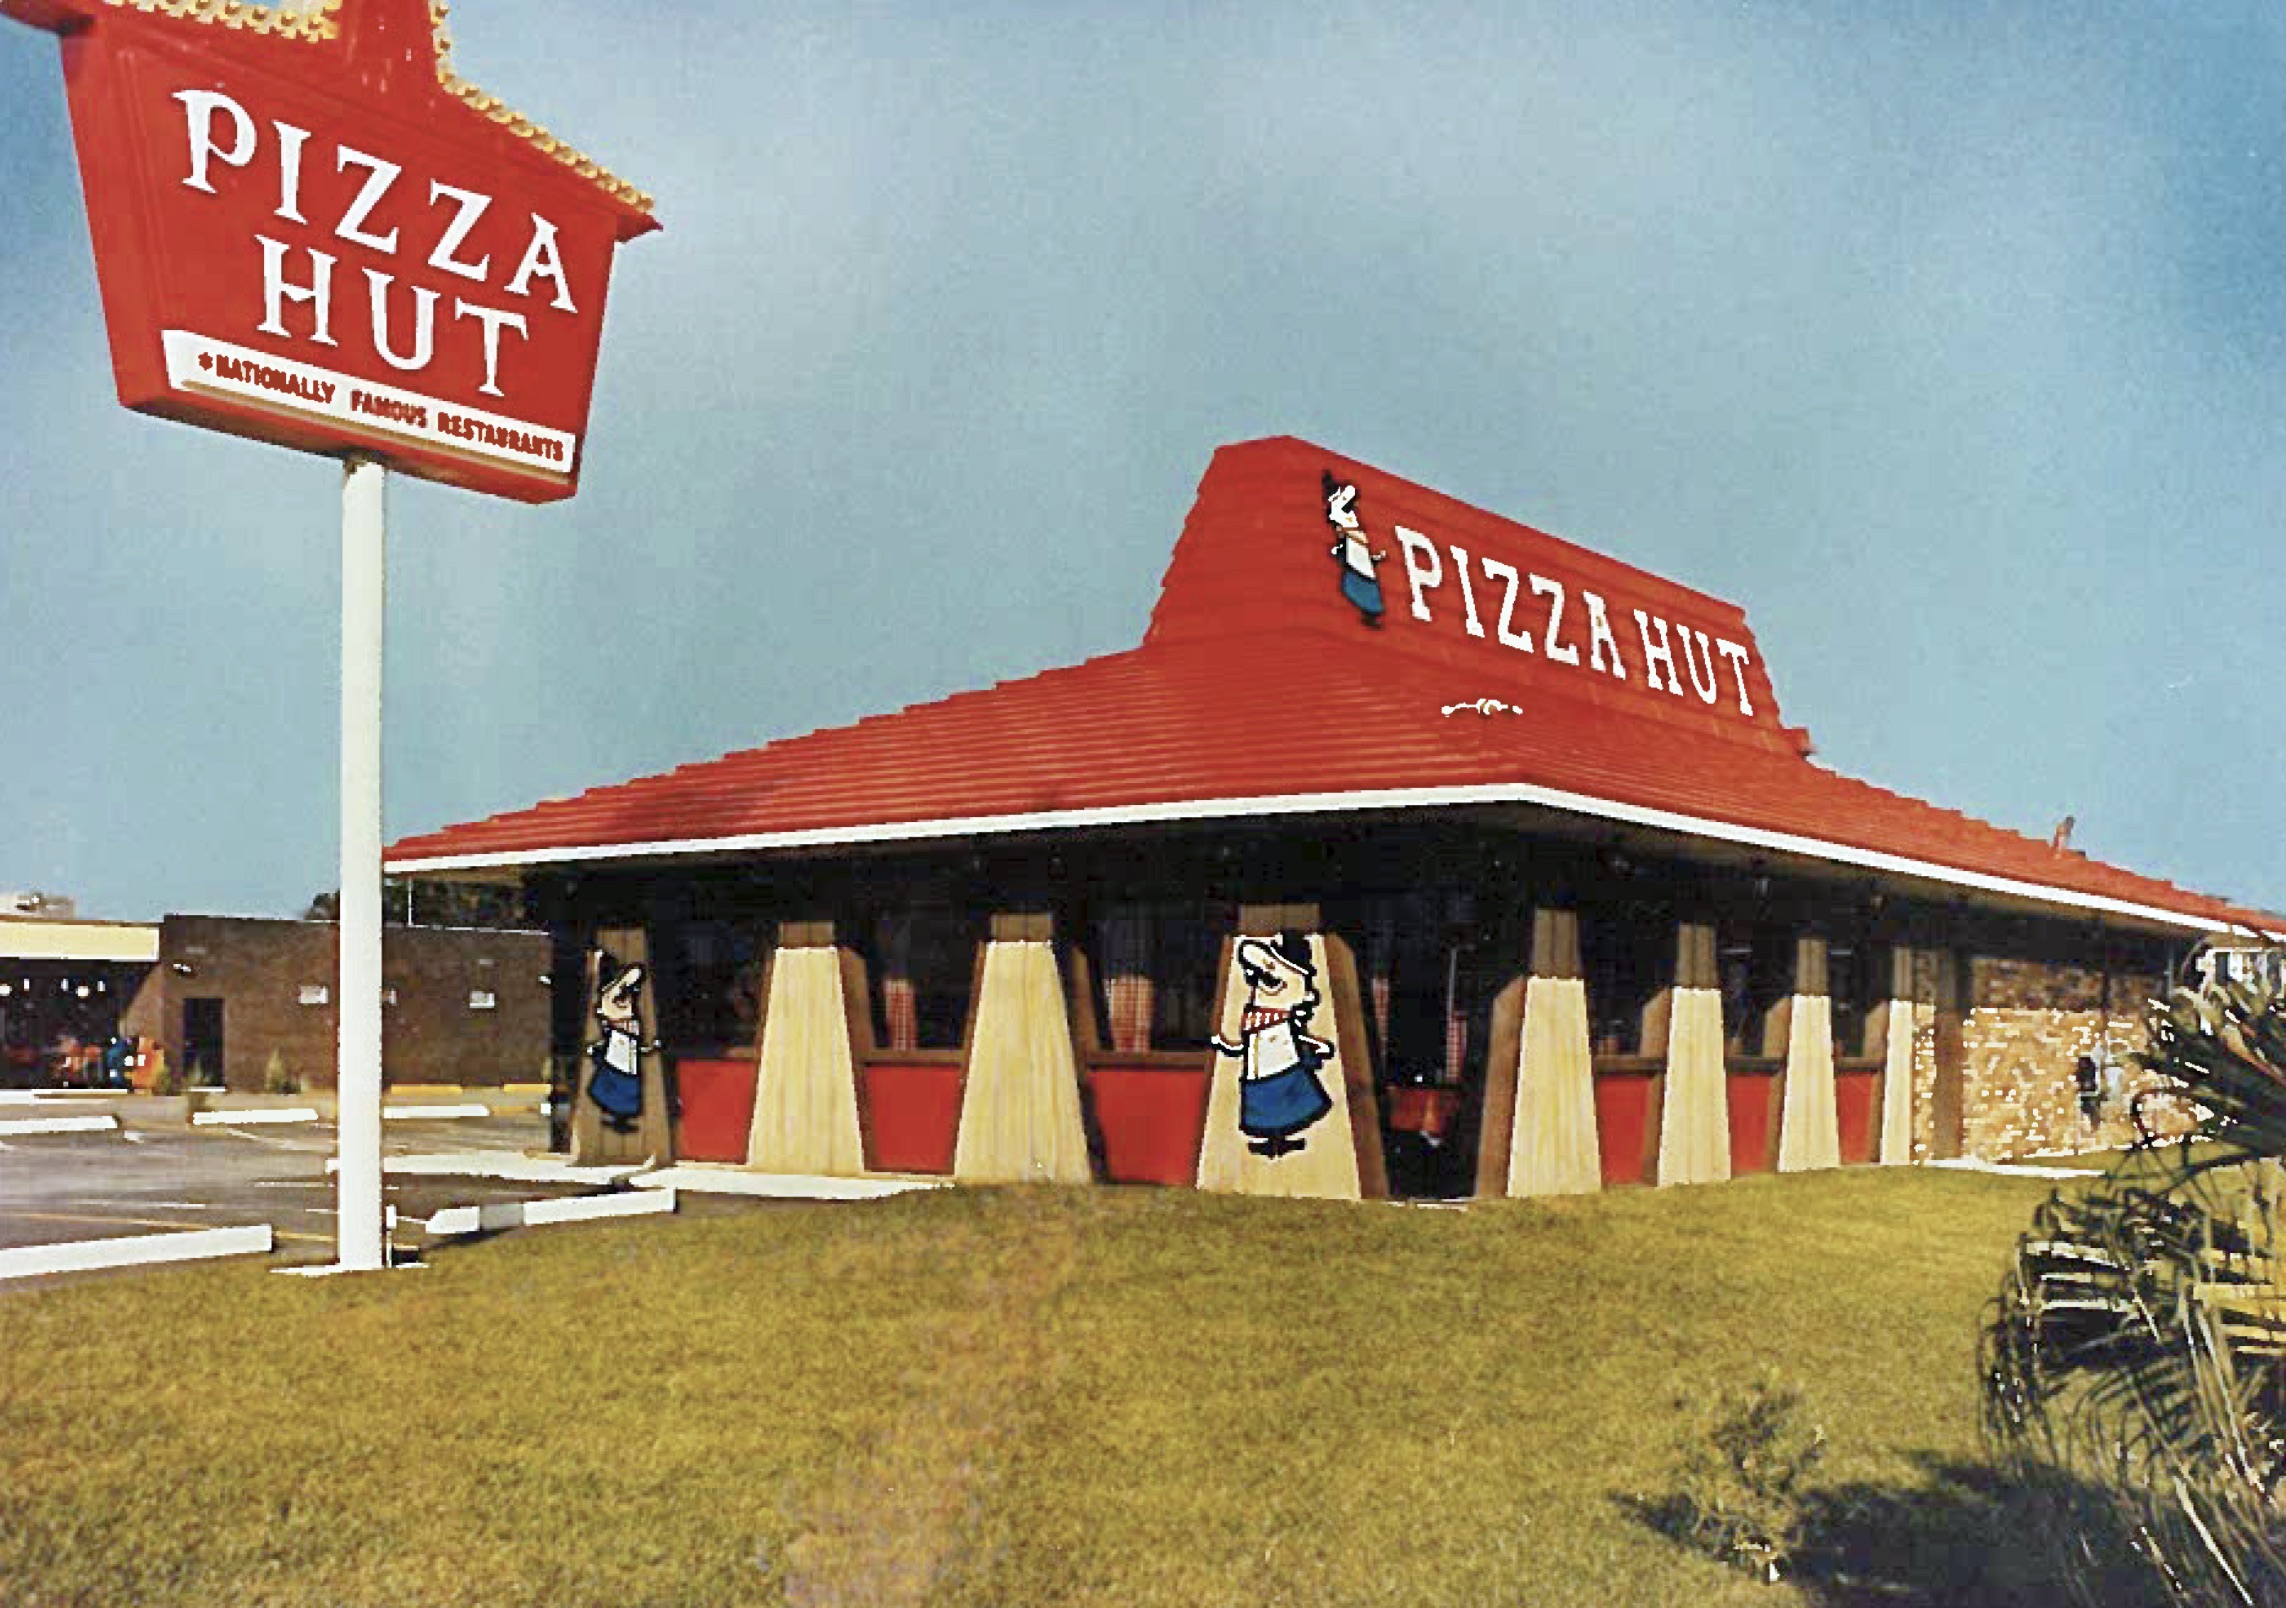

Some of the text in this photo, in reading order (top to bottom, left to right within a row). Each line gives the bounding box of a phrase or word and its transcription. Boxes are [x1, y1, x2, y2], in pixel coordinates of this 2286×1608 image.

[172, 89, 578, 314] PIZZA
[254, 234, 529, 397] HUT
[216, 354, 564, 462] NATIONALLY FAMOUS RESTAURANTS
[1394, 525, 1754, 717] PIZZA HUT
